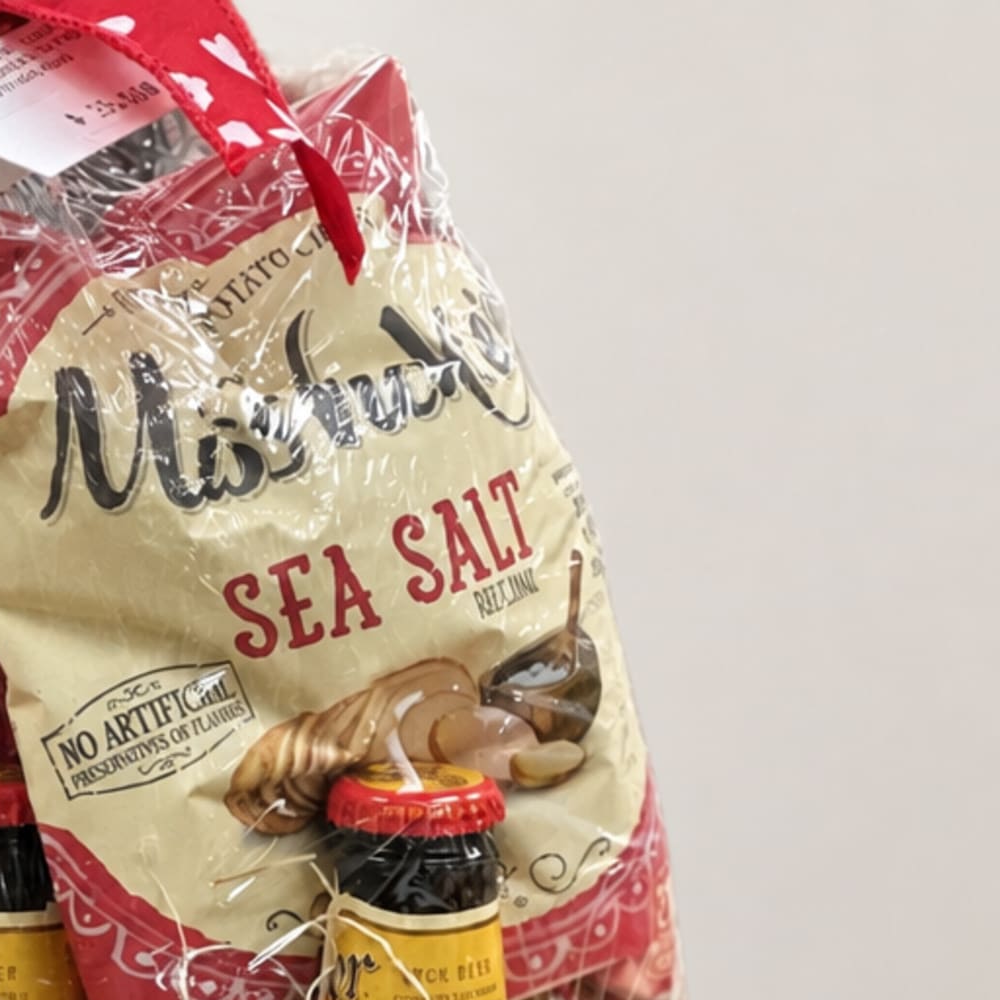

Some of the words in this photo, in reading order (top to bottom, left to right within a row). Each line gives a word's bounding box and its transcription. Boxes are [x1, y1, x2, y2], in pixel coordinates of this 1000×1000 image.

[224, 545, 381, 658] SEA
[392, 470, 533, 604] SALT
[58, 730, 99, 769] NO
